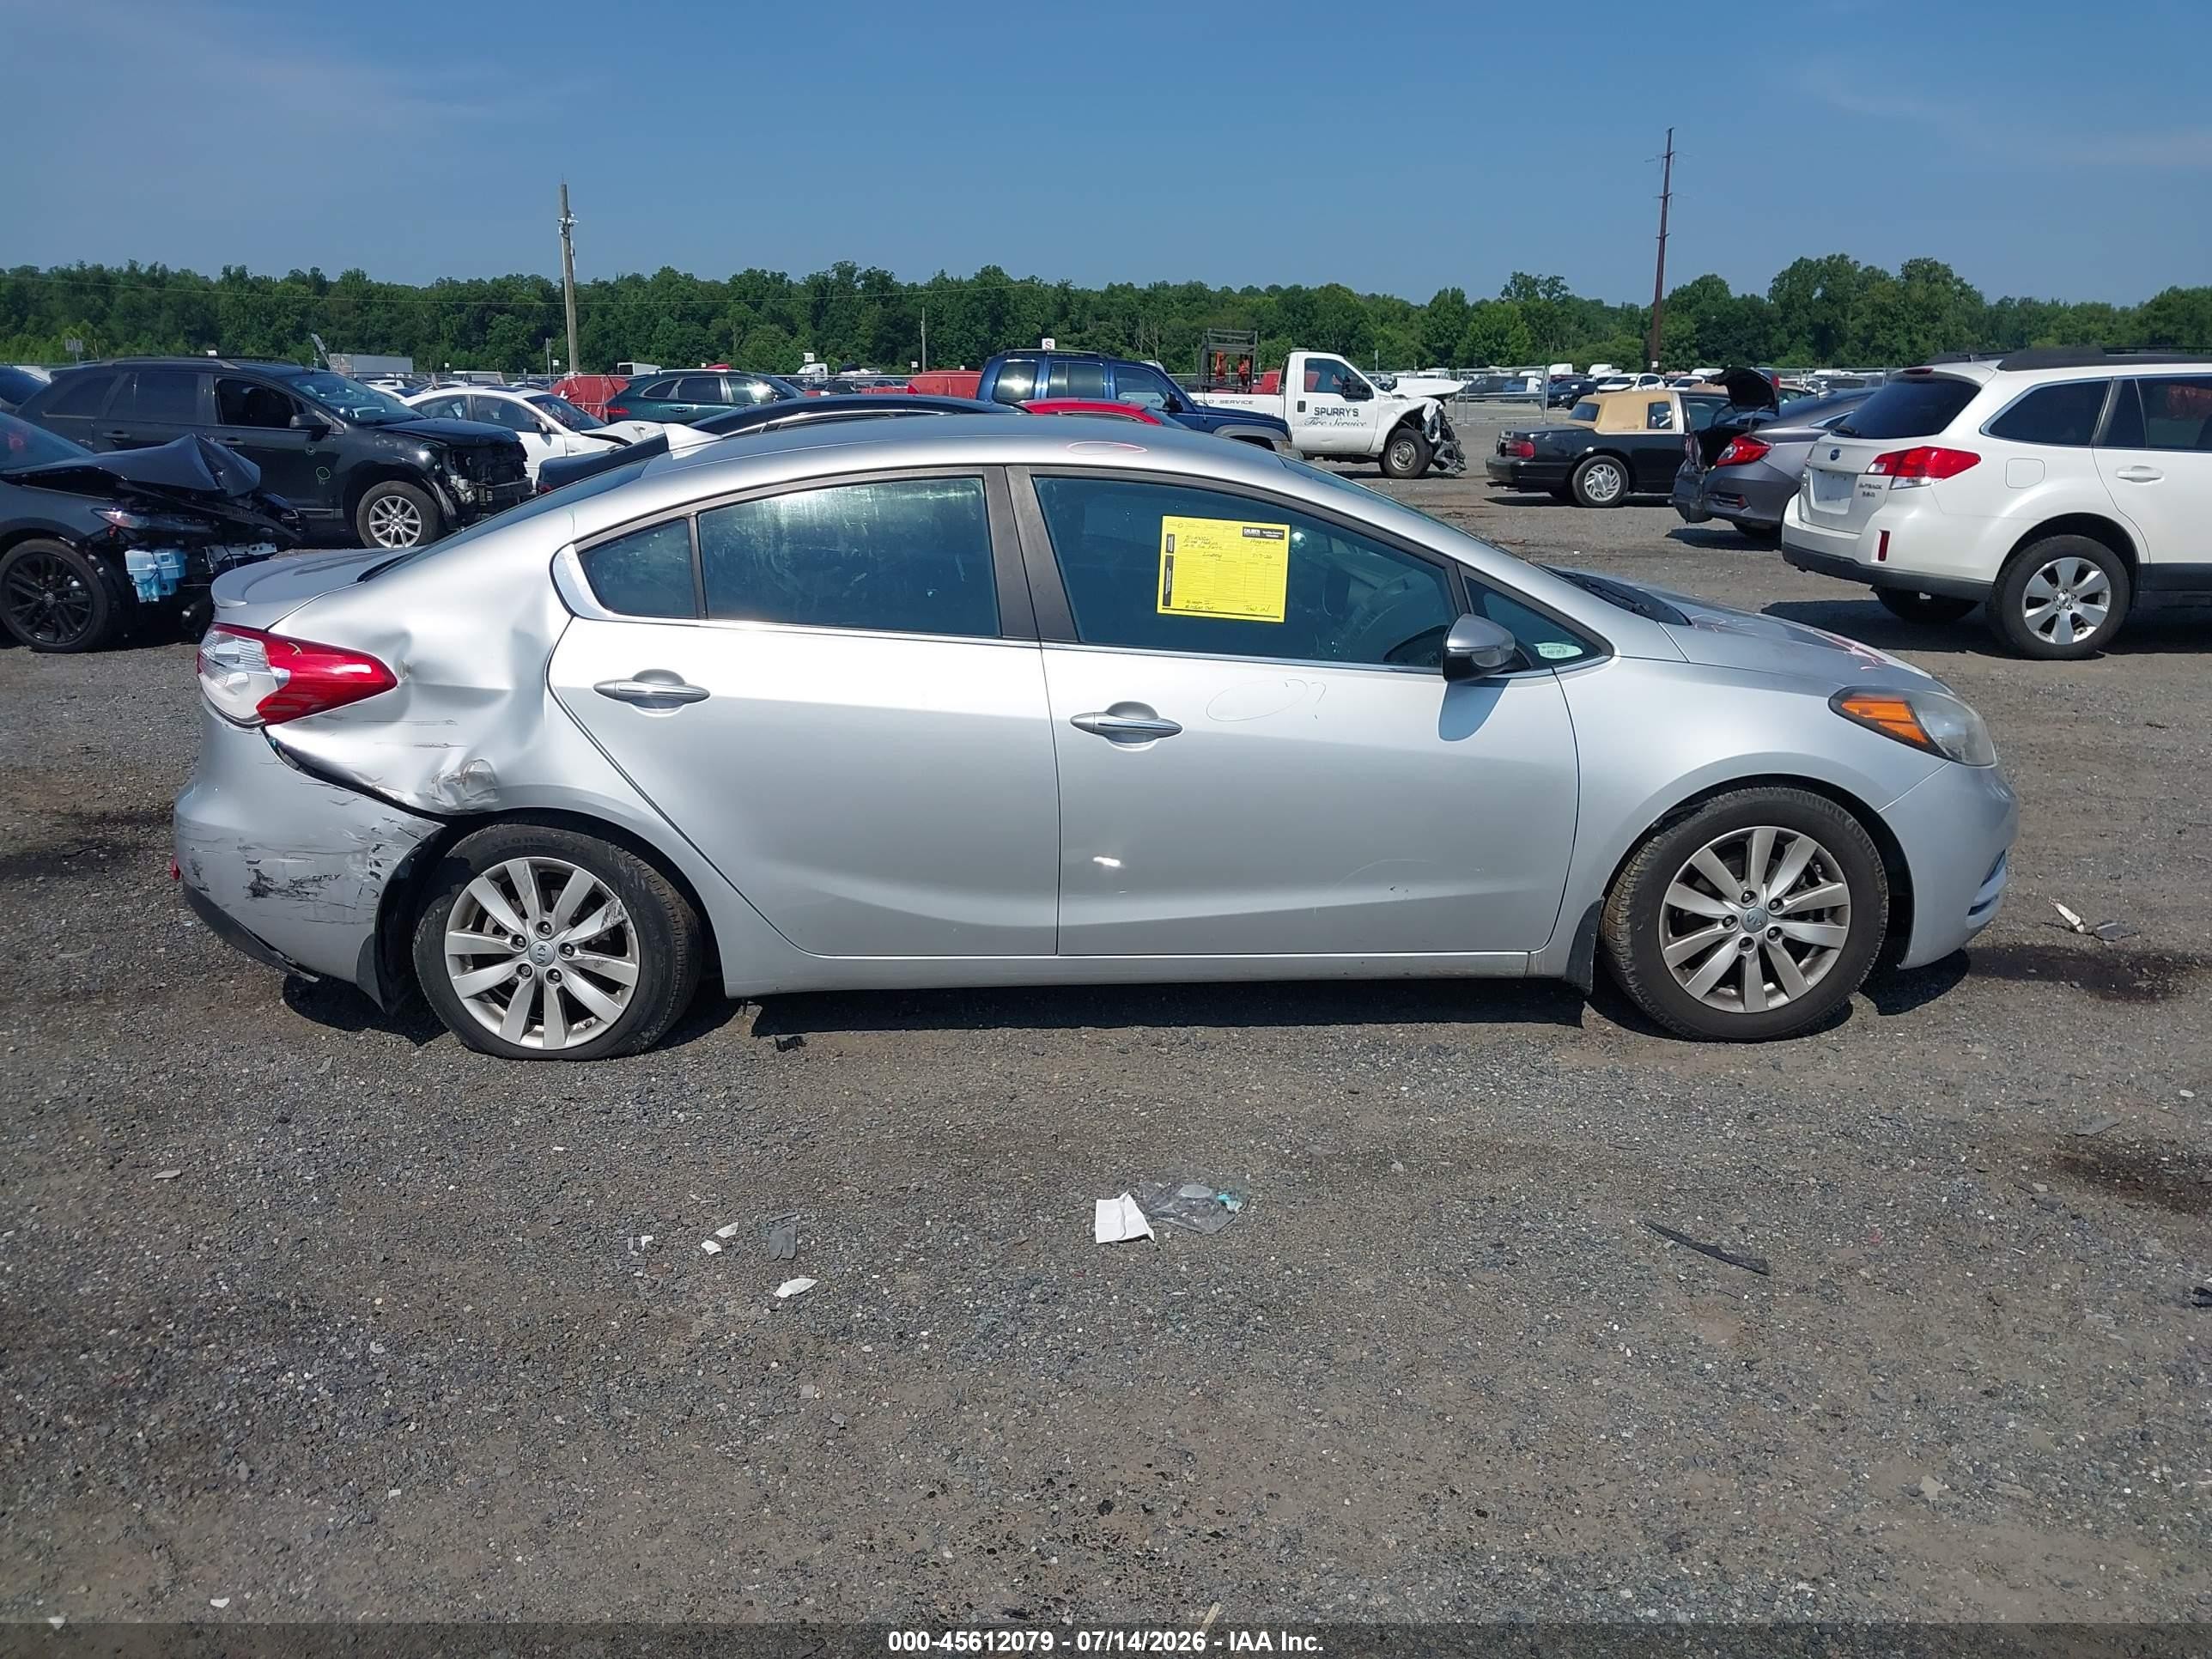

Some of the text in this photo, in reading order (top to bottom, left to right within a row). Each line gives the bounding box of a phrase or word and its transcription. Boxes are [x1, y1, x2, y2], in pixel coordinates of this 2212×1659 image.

[1045, 341, 1052, 350] S
[1304, 416, 1367, 427] Tire Service
[1747, 914, 1764, 927] KIA
[538, 945, 546, 963] KIA
